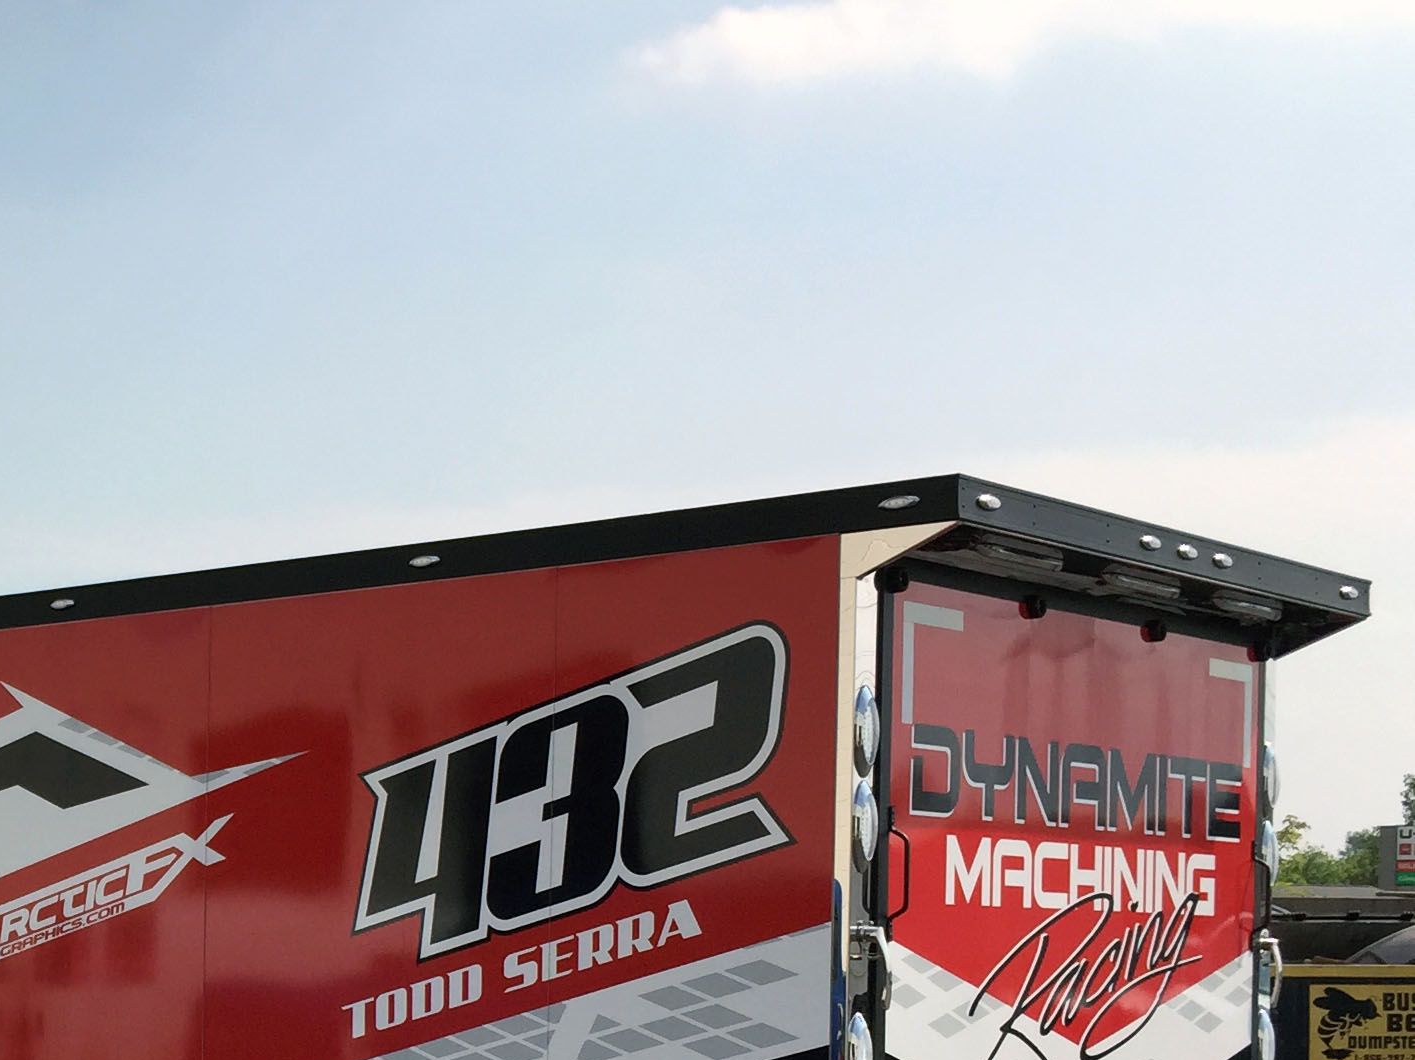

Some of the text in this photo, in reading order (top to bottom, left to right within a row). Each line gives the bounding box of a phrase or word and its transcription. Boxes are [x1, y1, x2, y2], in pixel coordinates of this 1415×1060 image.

[353, 619, 797, 961] 432
[909, 724, 1243, 843] DYNAMITE
[945, 834, 1216, 917] MACHINING
[341, 899, 702, 1040] TODD SERRA
